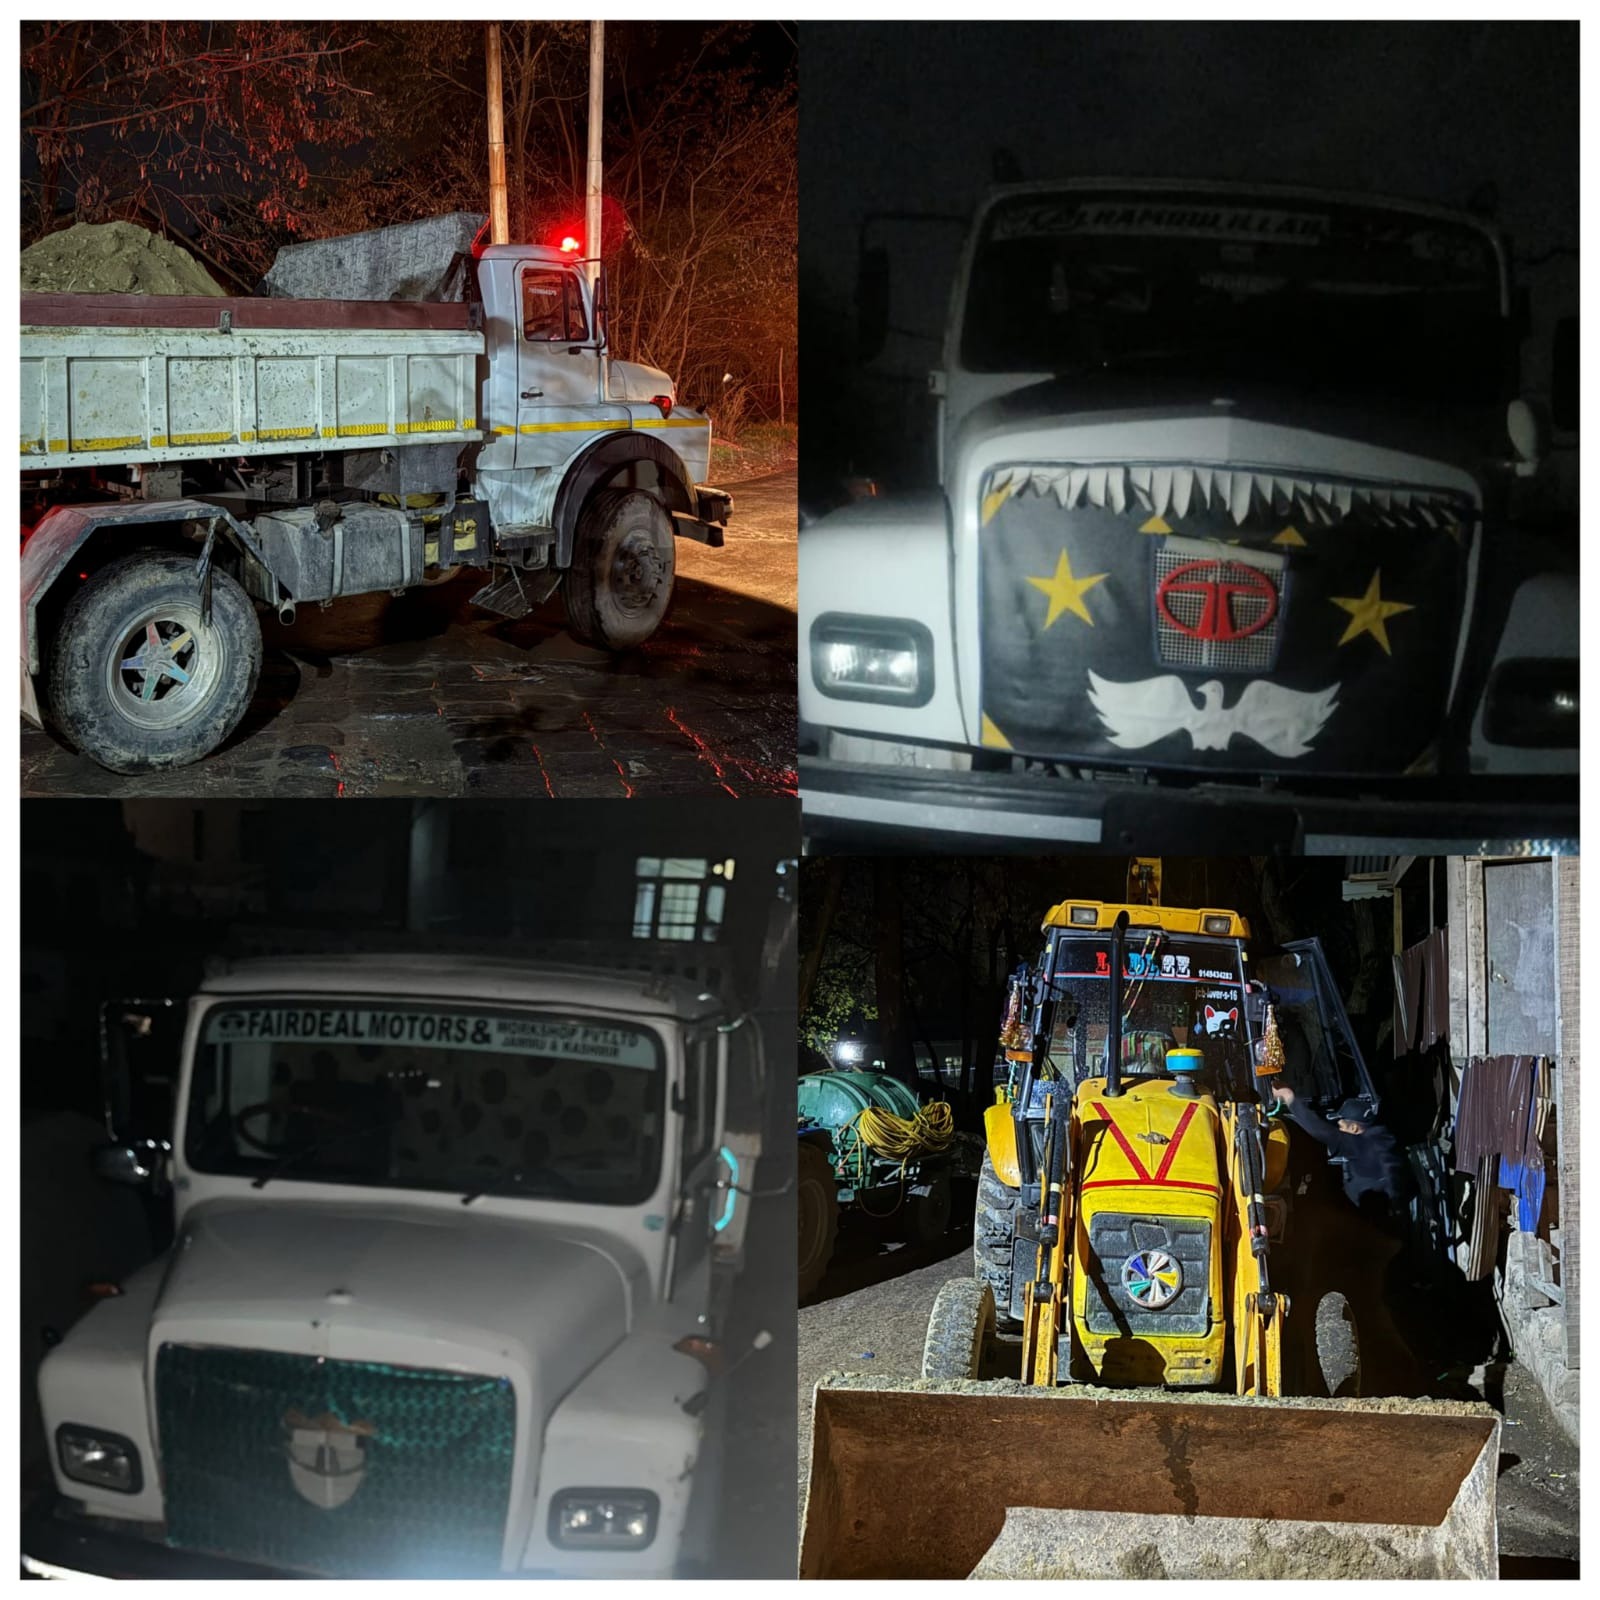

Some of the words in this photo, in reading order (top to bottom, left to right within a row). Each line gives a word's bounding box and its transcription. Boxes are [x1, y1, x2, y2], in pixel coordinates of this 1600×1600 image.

[248, 1012, 365, 1038] FAIRDEAL
[368, 1013, 467, 1043] MOTORS
[471, 1019, 491, 1044] &
[498, 1021, 578, 1039] WORKSHOP
[562, 1042, 619, 1057] KASHMIR
